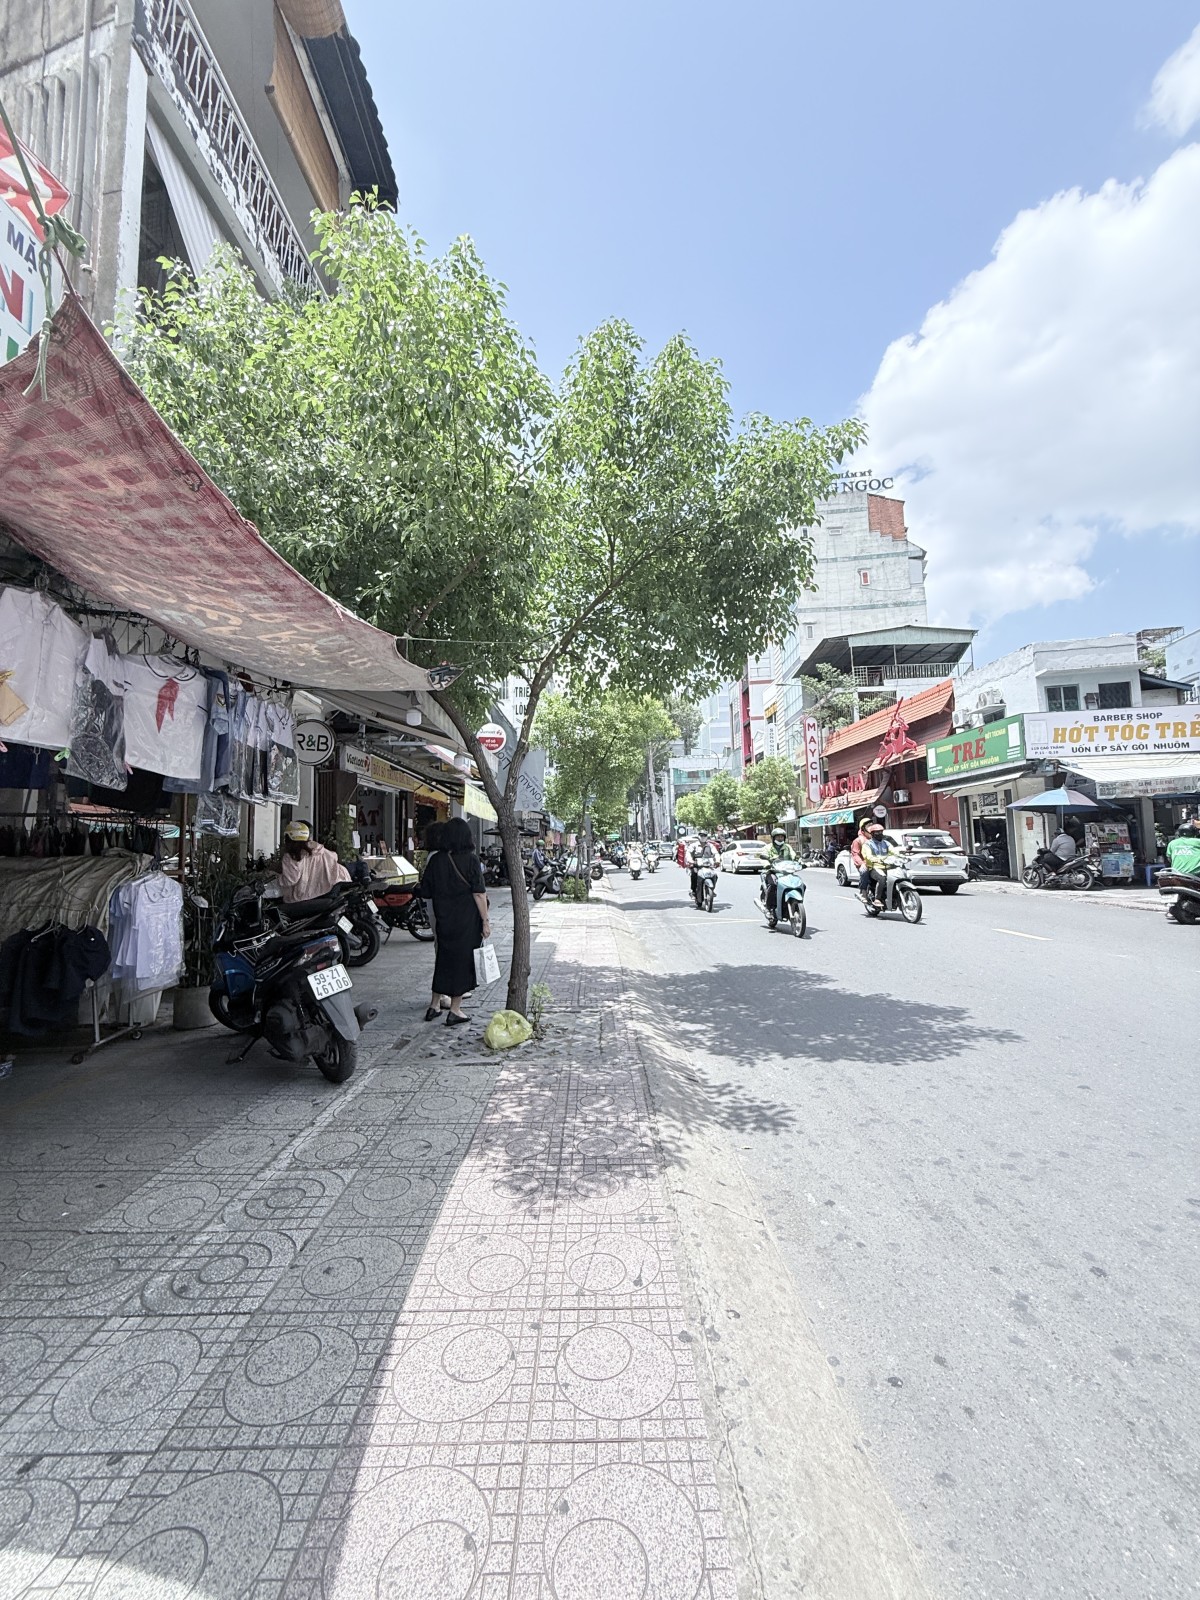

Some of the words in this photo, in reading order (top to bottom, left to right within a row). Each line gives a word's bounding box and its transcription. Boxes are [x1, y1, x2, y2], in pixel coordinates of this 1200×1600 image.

[1093, 714, 1133, 722] BARBER
[1136, 712, 1163, 720] SHOP
[1053, 720, 1099, 743] HỚT
[1104, 720, 1150, 741] TÓC
[951, 727, 986, 764] TRẺ
[1071, 743, 1091, 753] UỐN
[1095, 743, 1107, 752] ÉP
[1110, 742, 1129, 752] SẤY
[1153, 740, 1190, 750] NHUỘM
[313, 968, 340, 985] 59-Z1
[316, 977, 349, 996] 461.06
